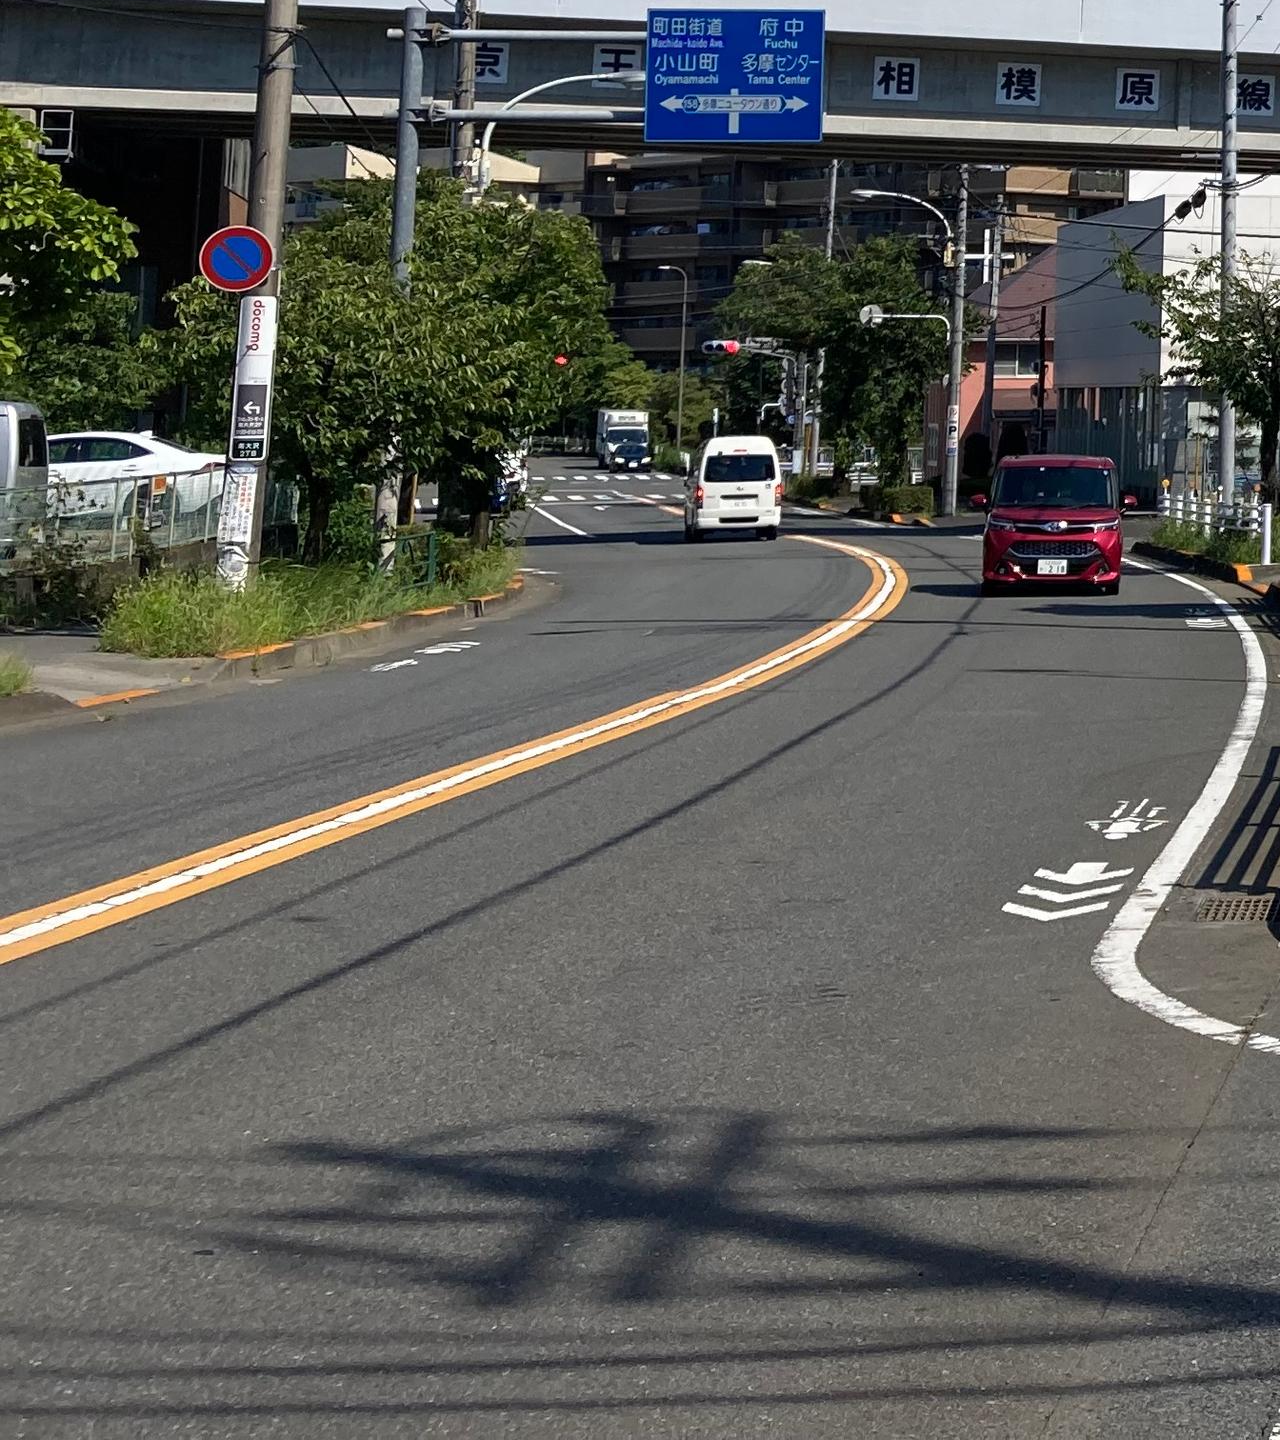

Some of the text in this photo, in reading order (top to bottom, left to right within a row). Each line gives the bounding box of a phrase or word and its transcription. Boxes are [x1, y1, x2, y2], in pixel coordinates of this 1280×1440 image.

[652, 16, 724, 37] 町田街道
[759, 17, 804, 37] 府中
[764, 38, 798, 49] Fuchu
[654, 53, 720, 73] 小山町
[741, 53, 820, 73] 多摩センター
[654, 74, 719, 86] Oyamamachi
[748, 74, 811, 85] Tama Center
[249, 300, 266, 351] docomo
